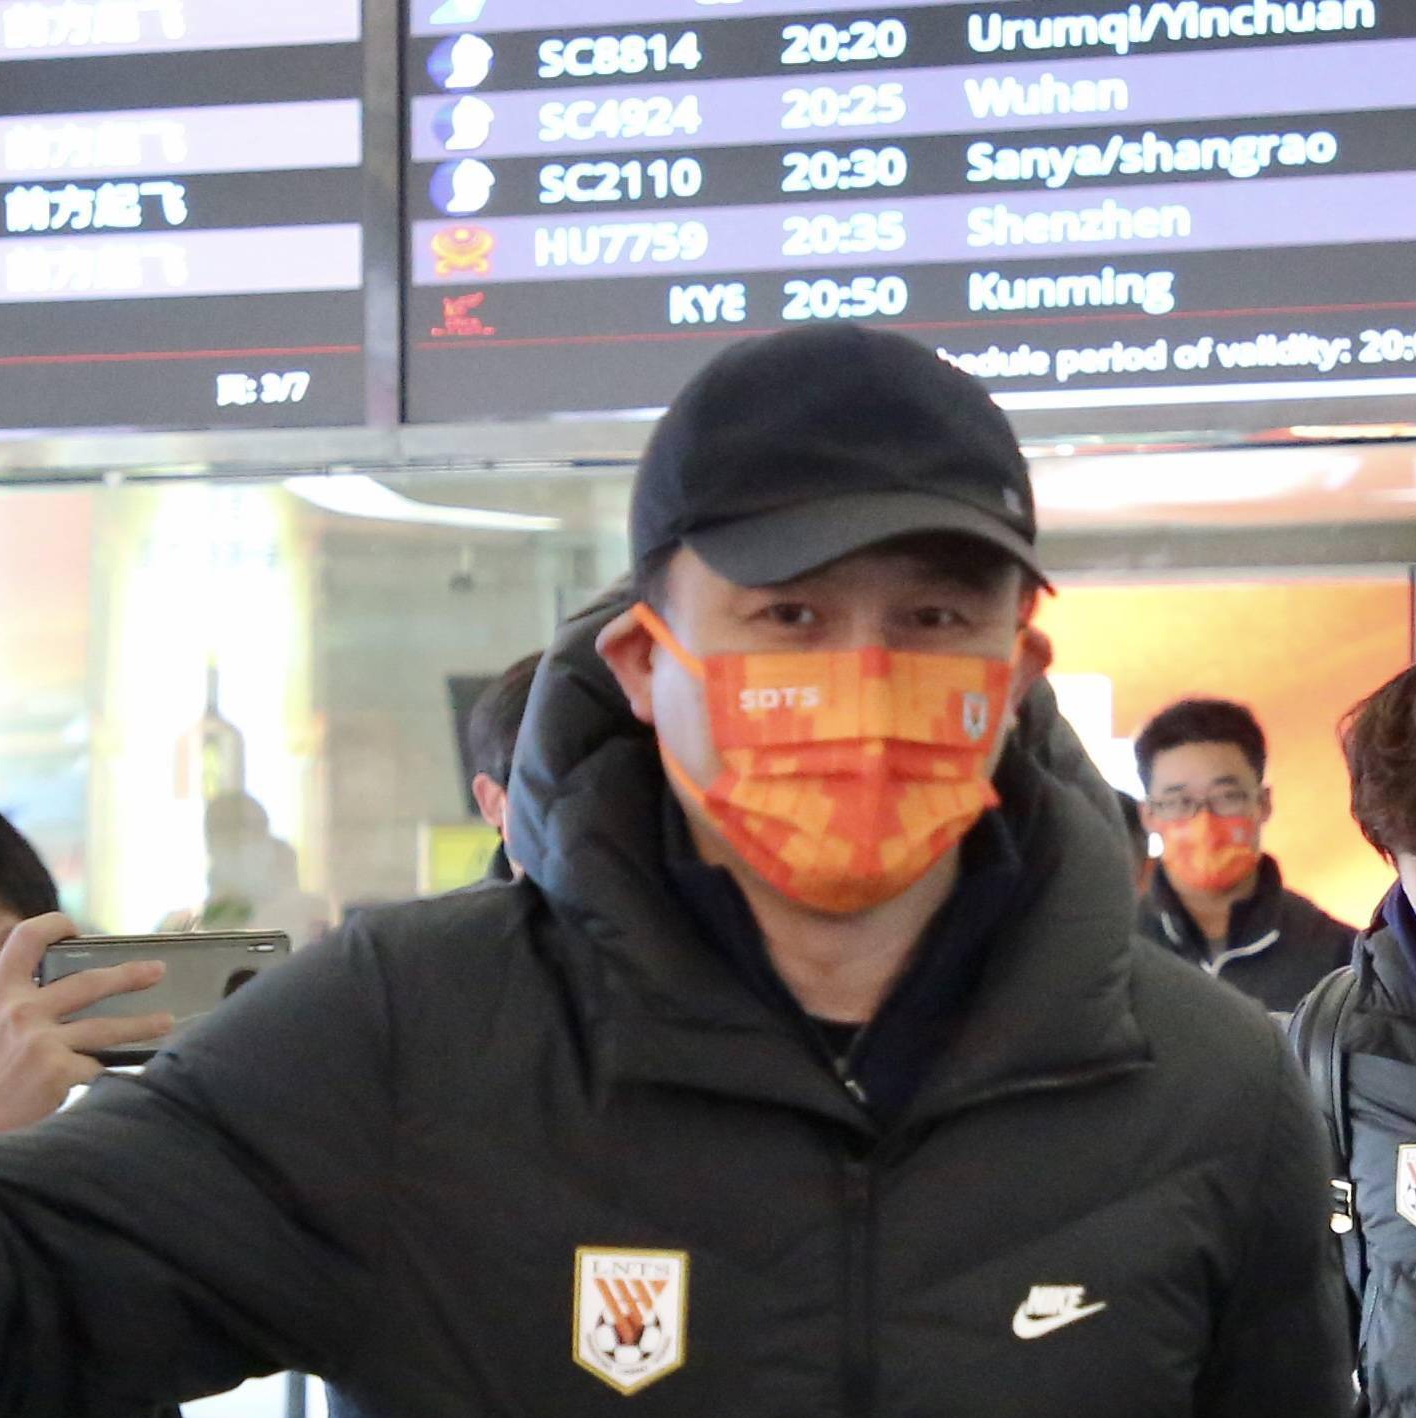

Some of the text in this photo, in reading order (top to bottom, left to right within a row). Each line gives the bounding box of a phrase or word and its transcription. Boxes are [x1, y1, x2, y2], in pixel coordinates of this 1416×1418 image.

[539, 33, 700, 77] SC8814
[782, 20, 906, 63] 20:20
[969, 0, 1375, 55] Urumqi/Yinchuan
[540, 96, 701, 140] SC4924
[783, 85, 905, 127] 20:25
[966, 74, 1127, 117] Wuhan
[540, 159, 701, 202] SC2110
[782, 148, 906, 191] 20:30
[967, 131, 1337, 187] Sanya/shangrao
[7, 182, 187, 231] 前方起飞
[535, 224, 707, 265] HU7759
[783, 214, 905, 254] 20:35
[968, 202, 1190, 245] Shenzhen
[670, 284, 745, 323] KYE
[783, 277, 907, 319] 20:50
[970, 268, 1174, 314] Kunming
[937, 345, 1050, 377] edule
[1056, 339, 1167, 381] period
[1174, 337, 1213, 369] of
[1217, 334, 1351, 371] validity:
[739, 687, 822, 711] SDTS
